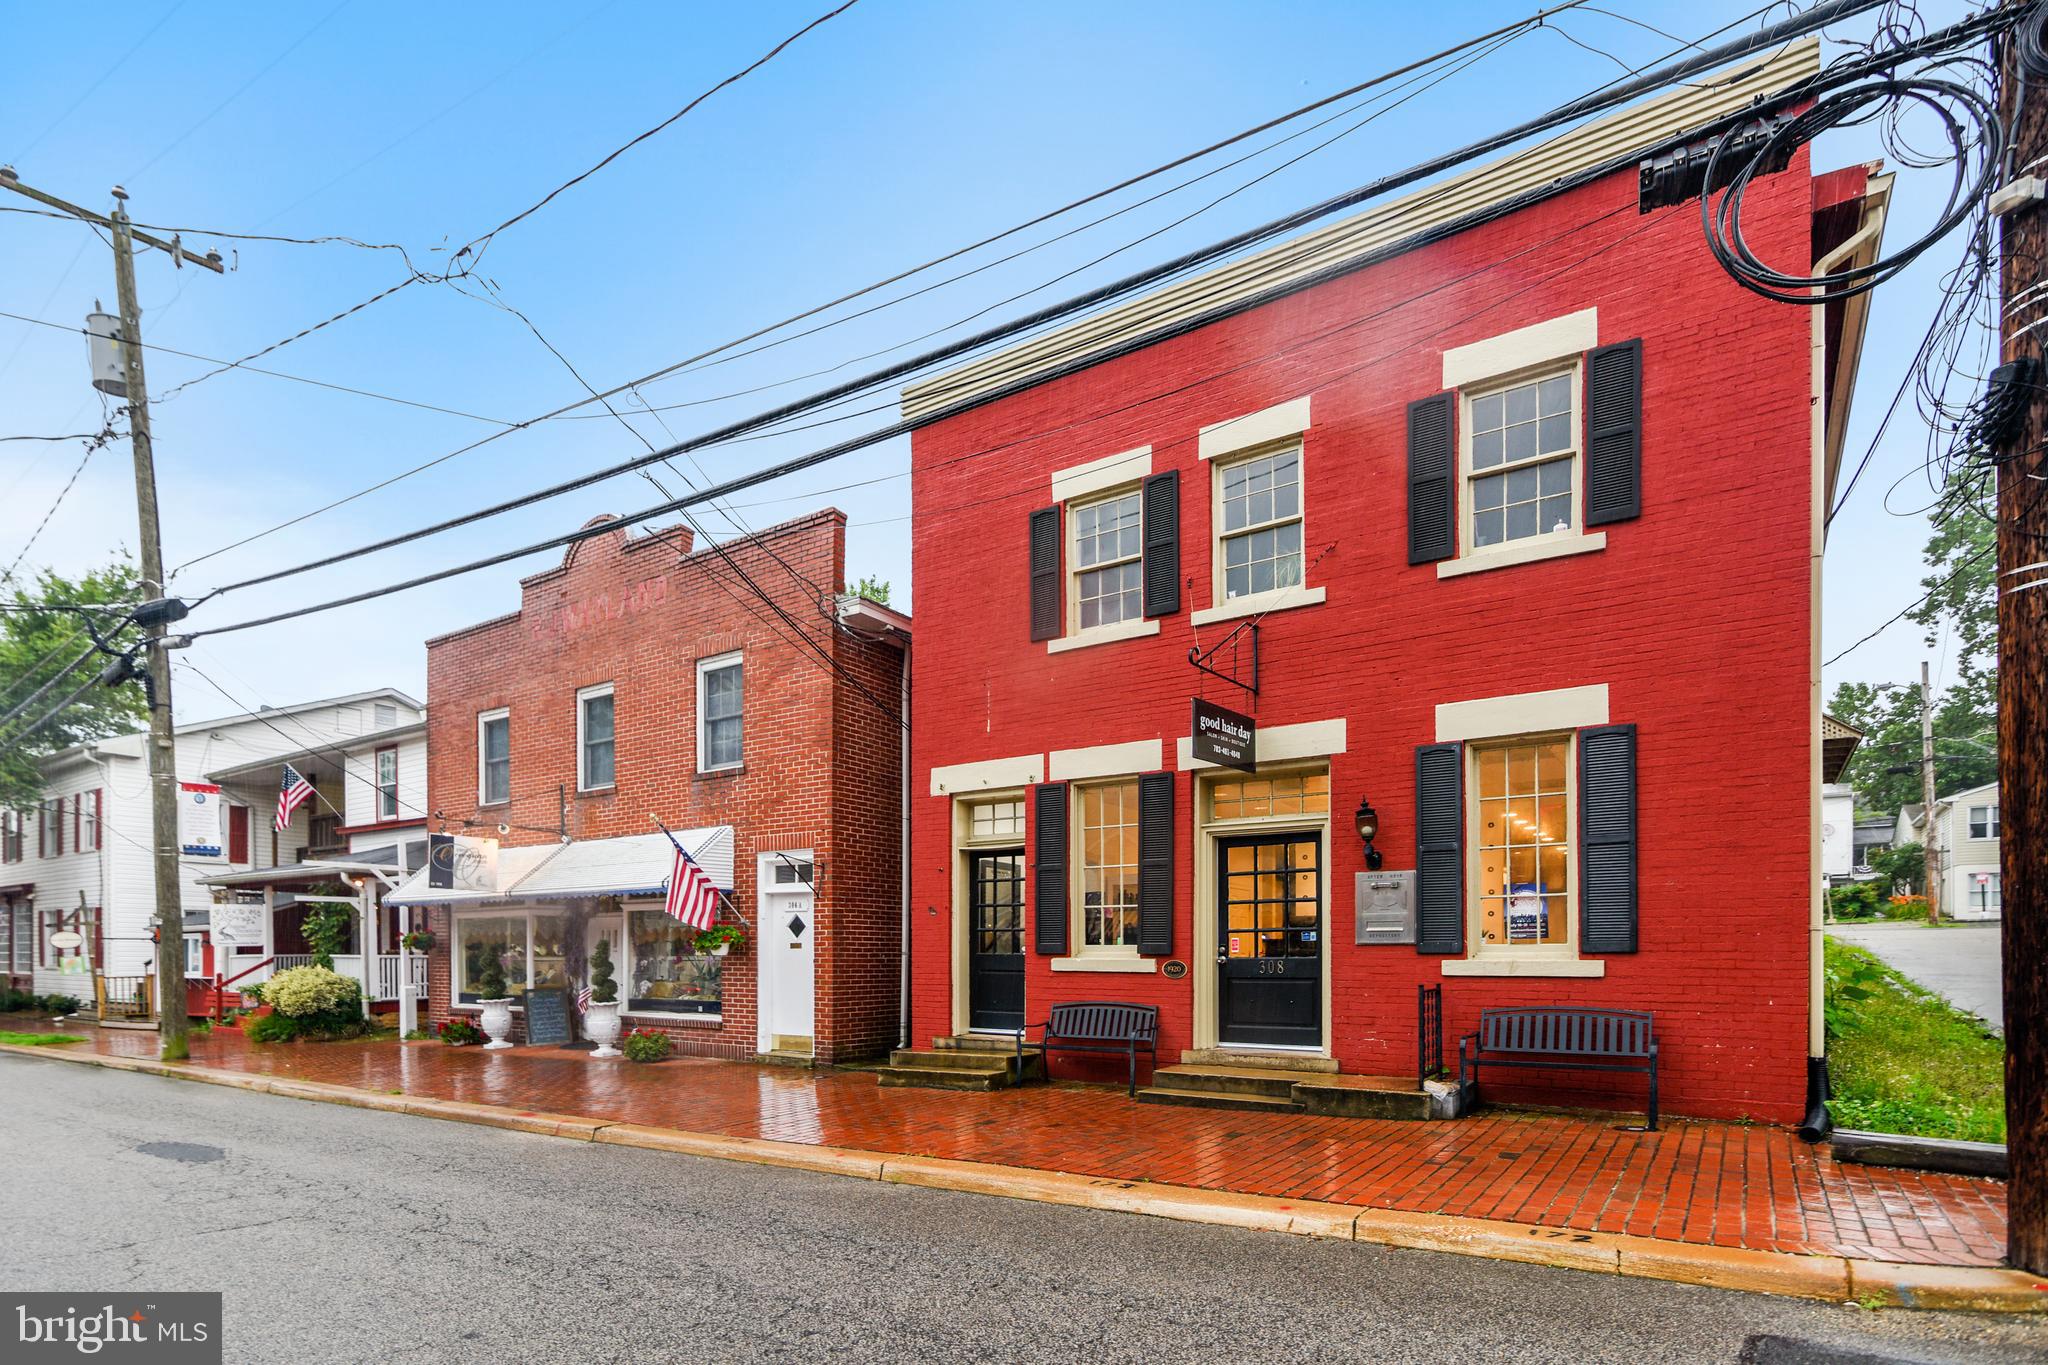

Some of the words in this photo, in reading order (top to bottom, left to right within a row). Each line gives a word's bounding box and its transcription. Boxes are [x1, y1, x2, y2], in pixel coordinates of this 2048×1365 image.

[1200, 716, 1220, 730] good
[1222, 719, 1237, 736] hair
[1238, 725, 1251, 744] day
[1259, 960, 1284, 974] 308
